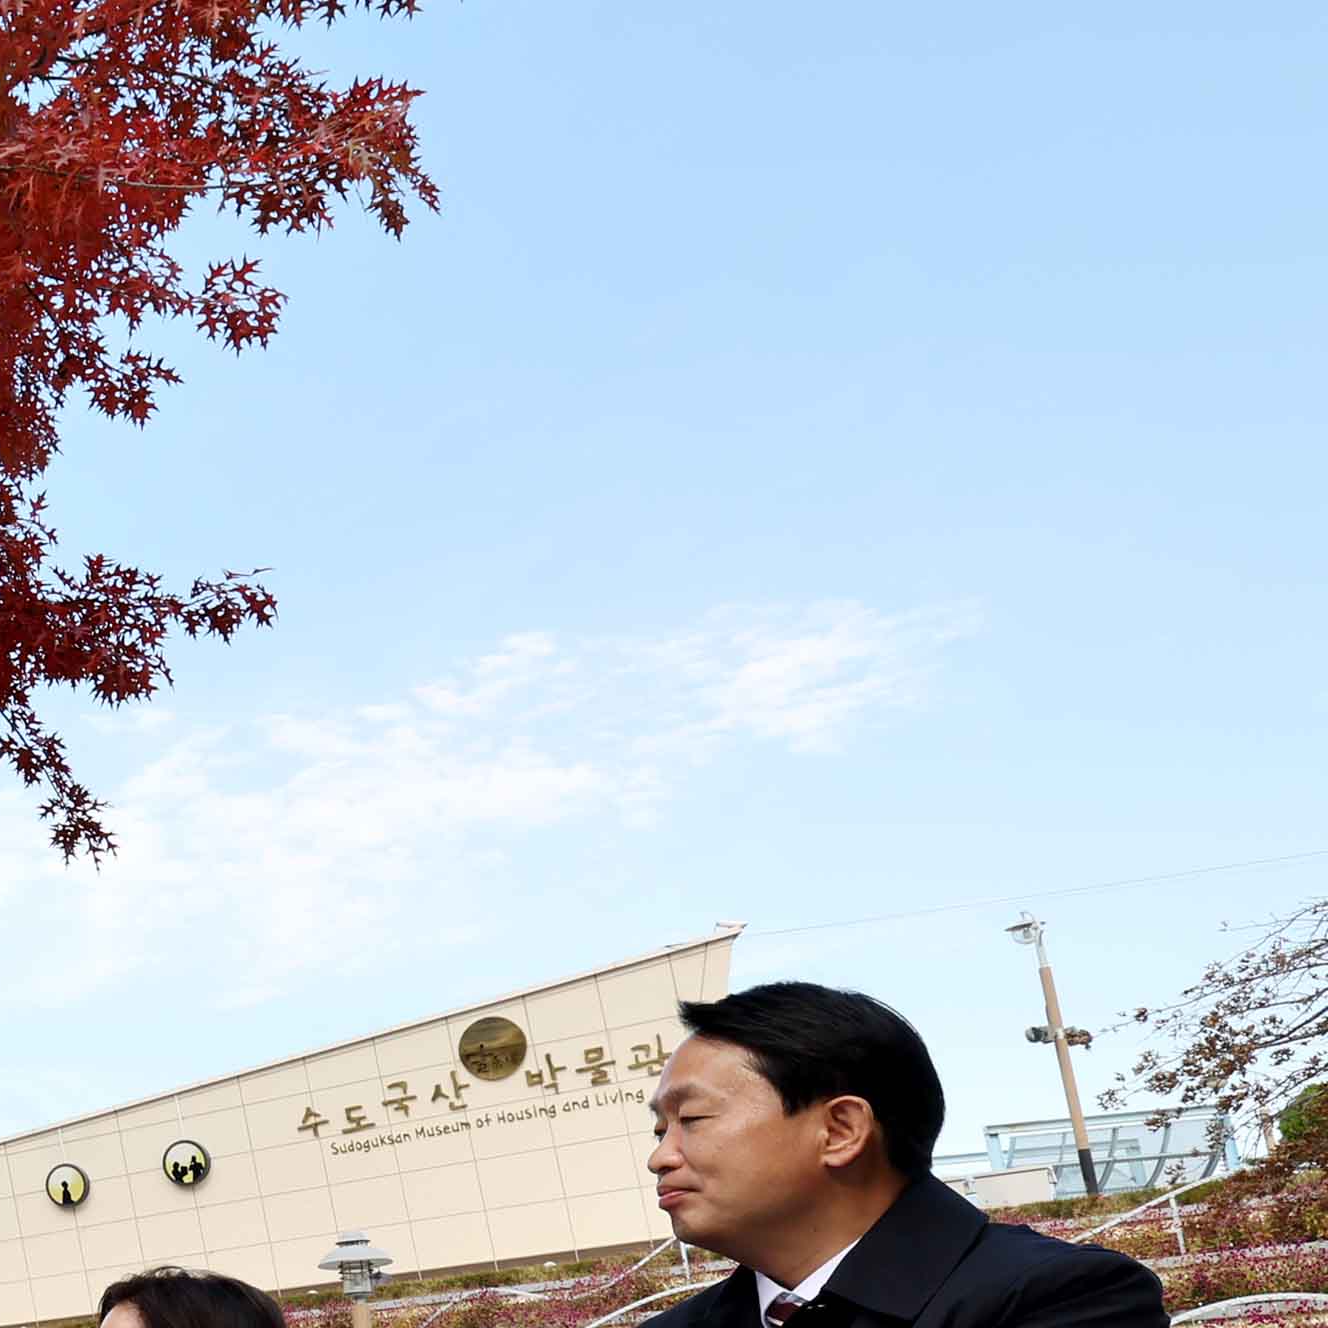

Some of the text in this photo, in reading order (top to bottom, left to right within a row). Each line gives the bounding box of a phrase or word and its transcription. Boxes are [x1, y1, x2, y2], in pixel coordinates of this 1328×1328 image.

[525, 1034, 672, 1095] 박물관
[330, 1088, 645, 1155] Sudoguksan Museum of Housing and Living
